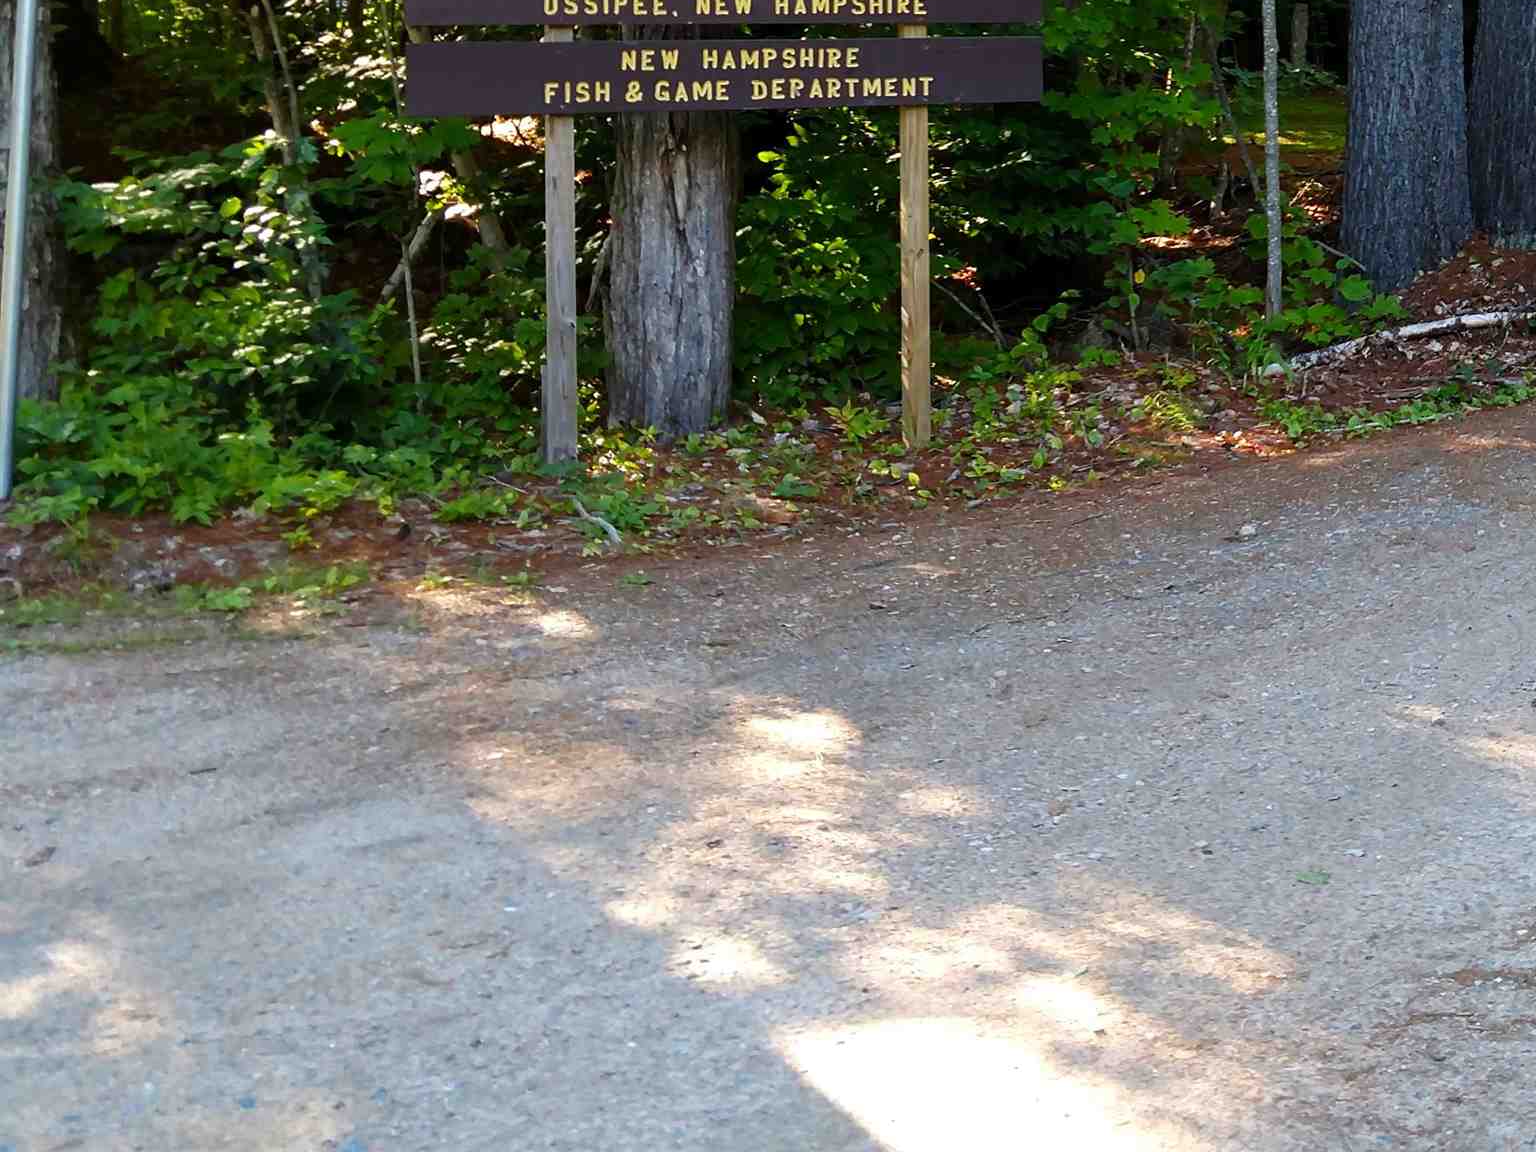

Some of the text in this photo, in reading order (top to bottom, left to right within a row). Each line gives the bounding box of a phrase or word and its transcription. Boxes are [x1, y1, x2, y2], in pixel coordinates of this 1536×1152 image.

[621, 47, 860, 72] NEW HAMPSHIRE
[544, 76, 935, 104] FISH & GAME DEPARTMENT
